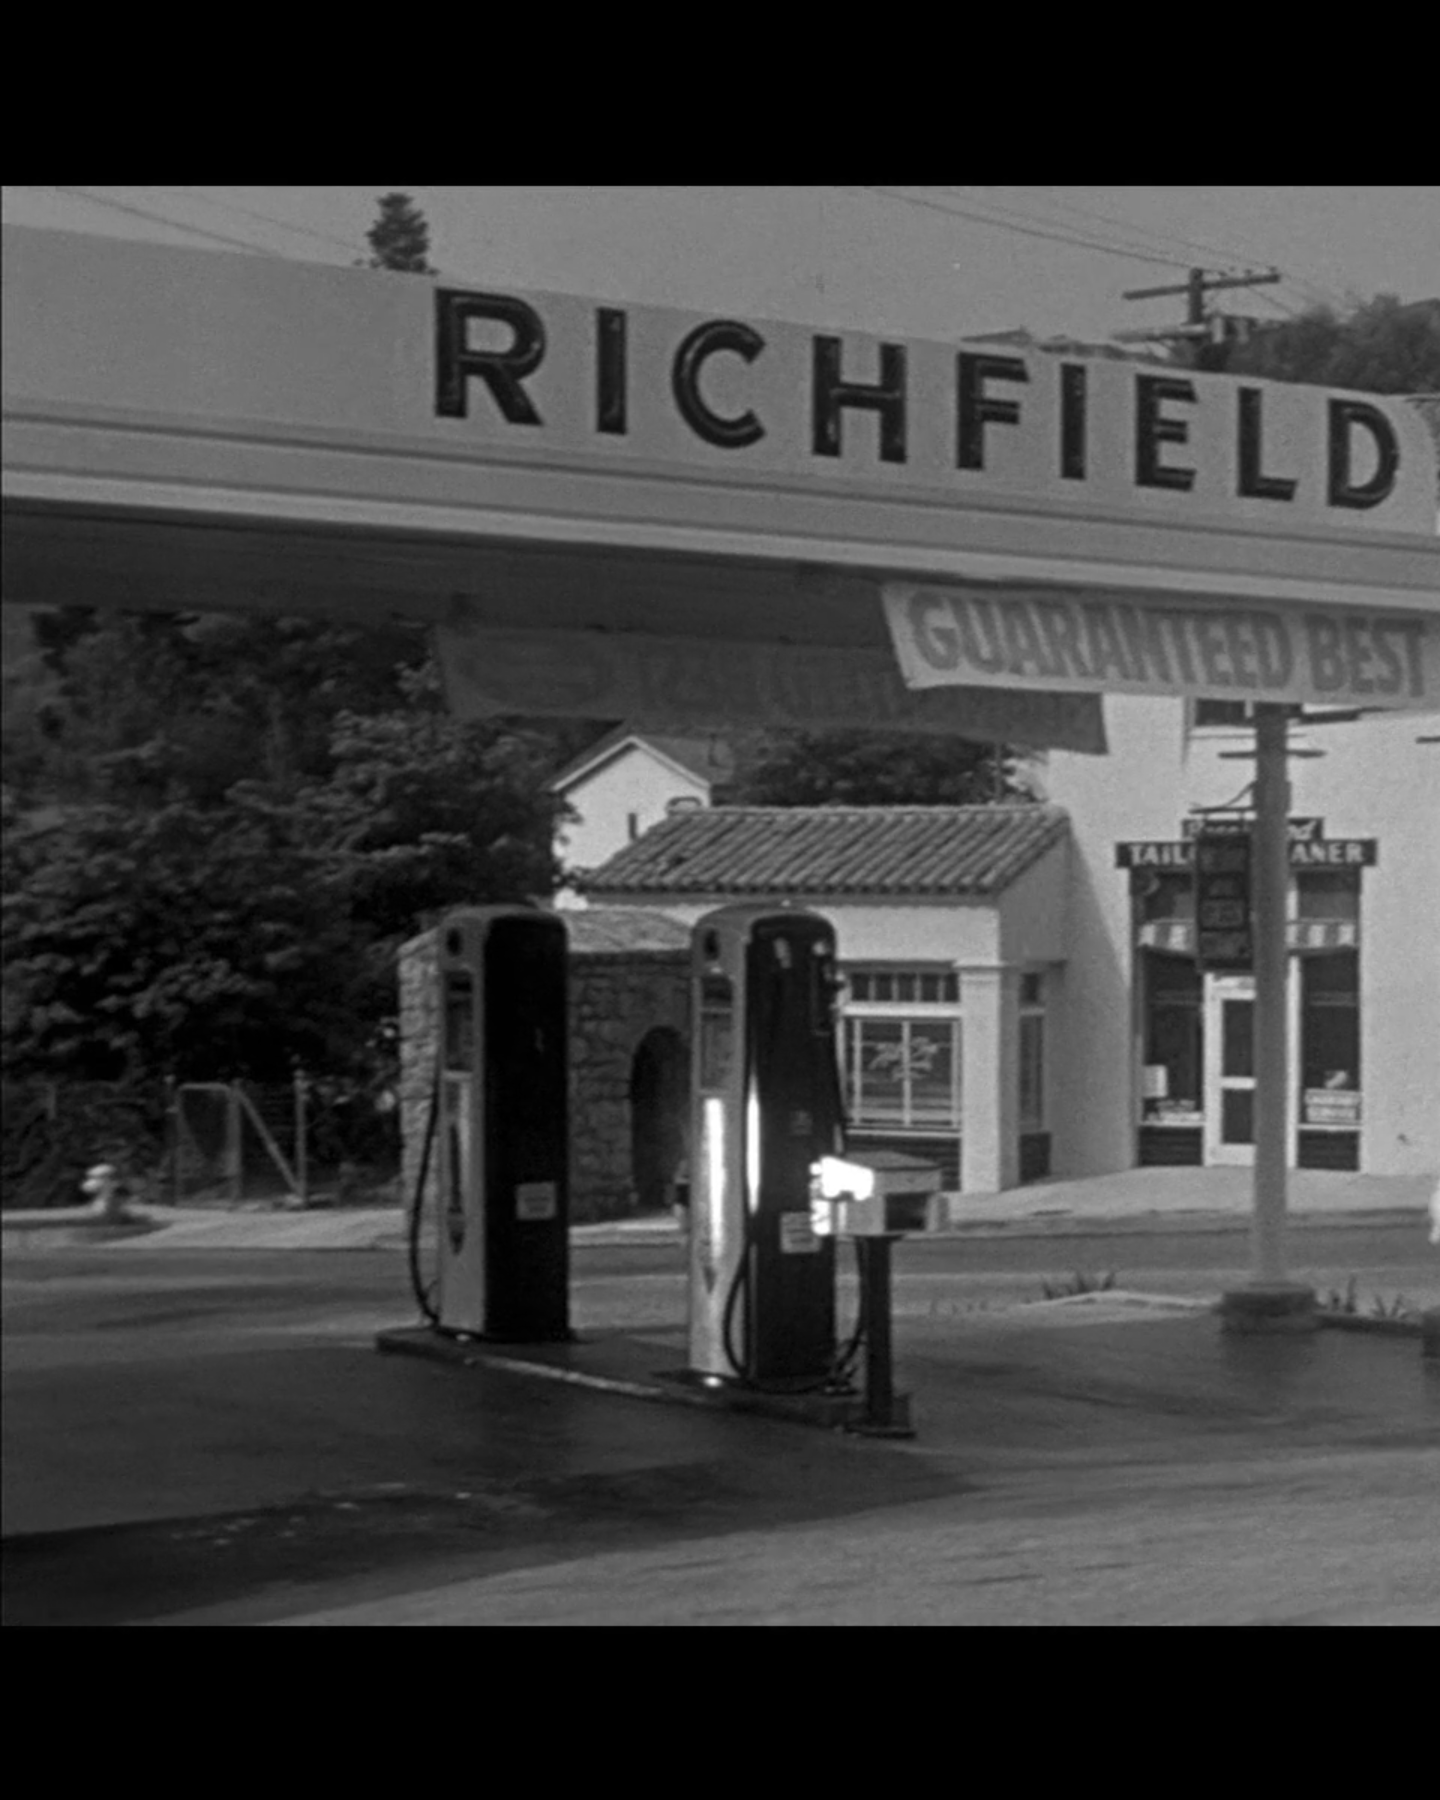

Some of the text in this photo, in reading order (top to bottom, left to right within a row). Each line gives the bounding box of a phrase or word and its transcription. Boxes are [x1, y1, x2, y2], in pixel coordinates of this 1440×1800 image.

[434, 286, 1400, 510] RICHFIELD
[905, 596, 1425, 698] GUARANTEED BEST
[1130, 843, 1364, 867] TAIL ANER
